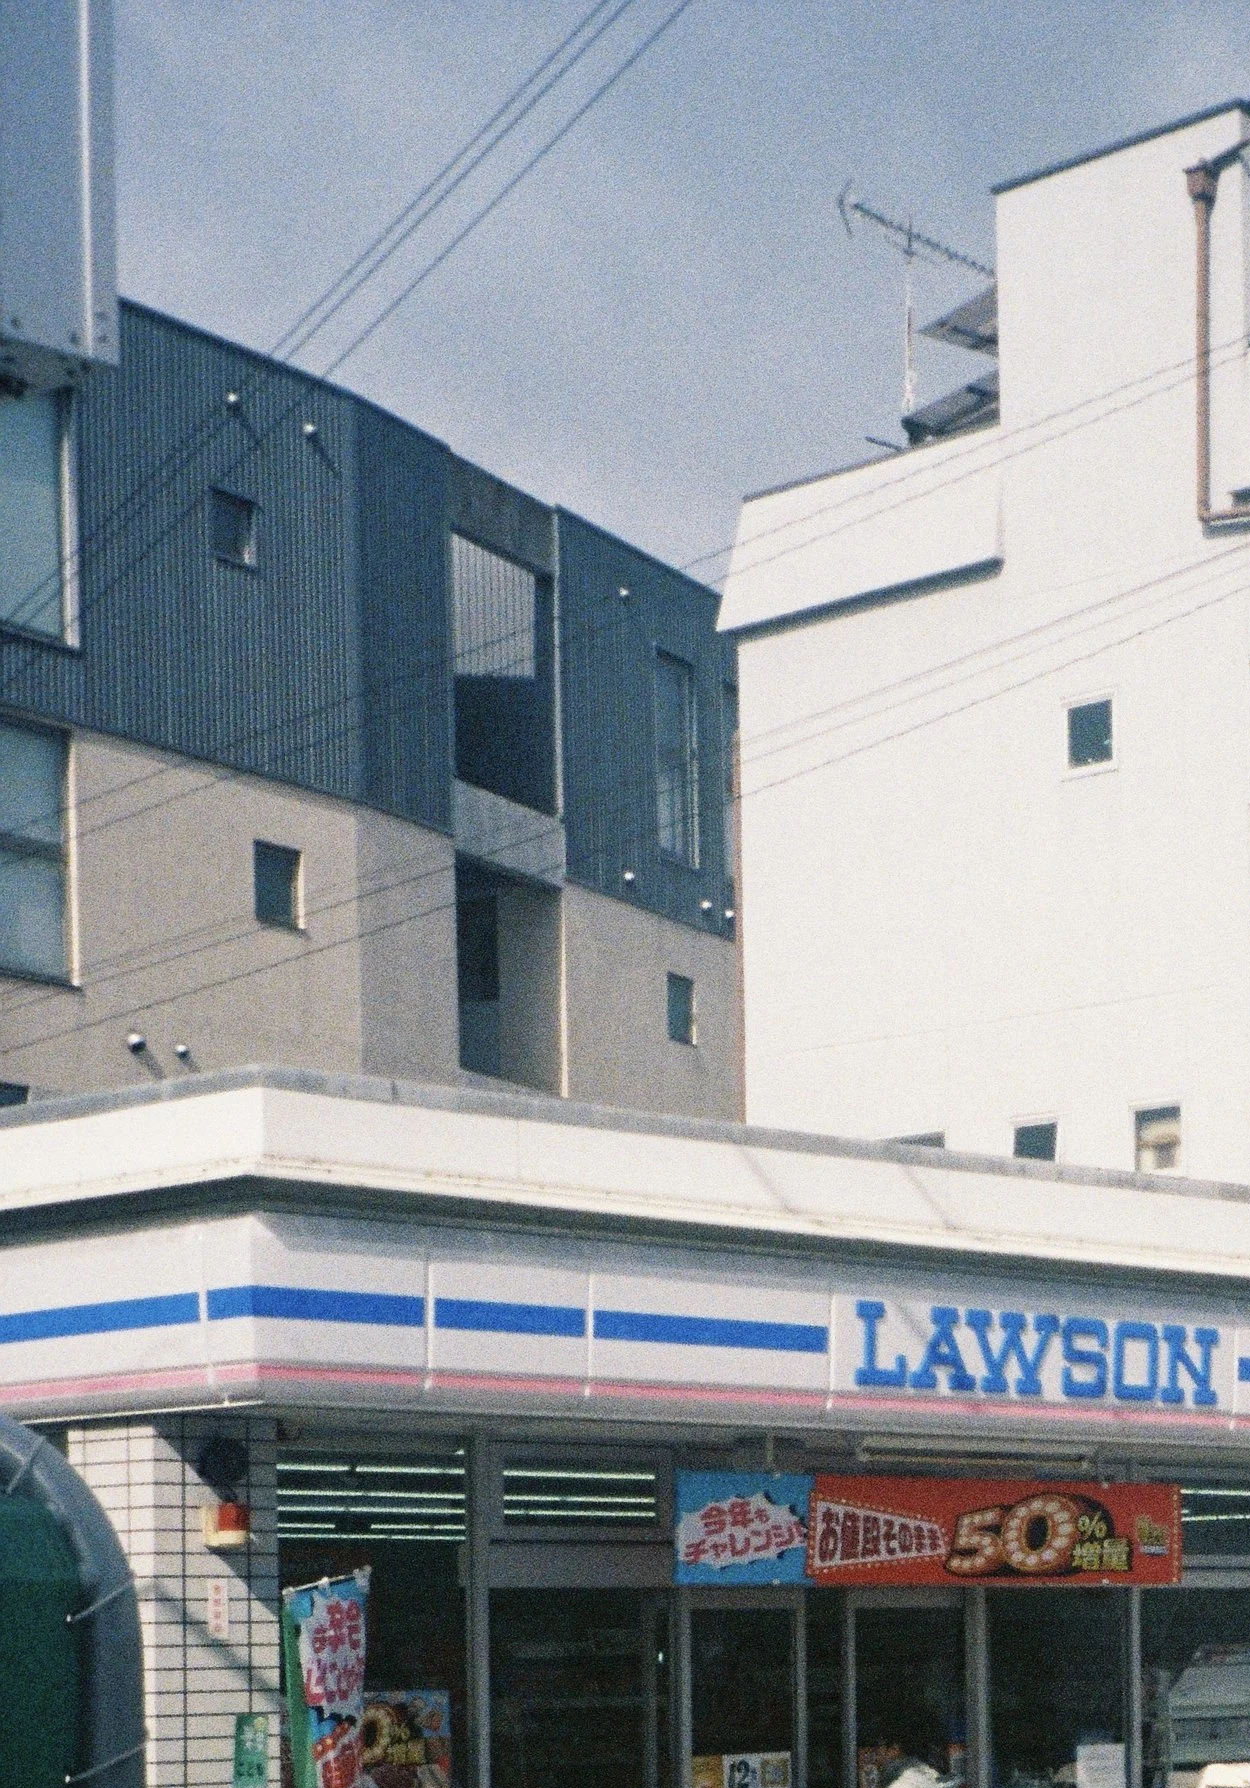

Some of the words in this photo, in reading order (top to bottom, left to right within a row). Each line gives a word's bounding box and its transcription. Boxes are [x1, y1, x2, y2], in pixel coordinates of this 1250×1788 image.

[856, 1300, 1219, 1406] LAWSON
[701, 1500, 770, 1536] 今年も
[818, 1507, 942, 1563] お値段そのまま
